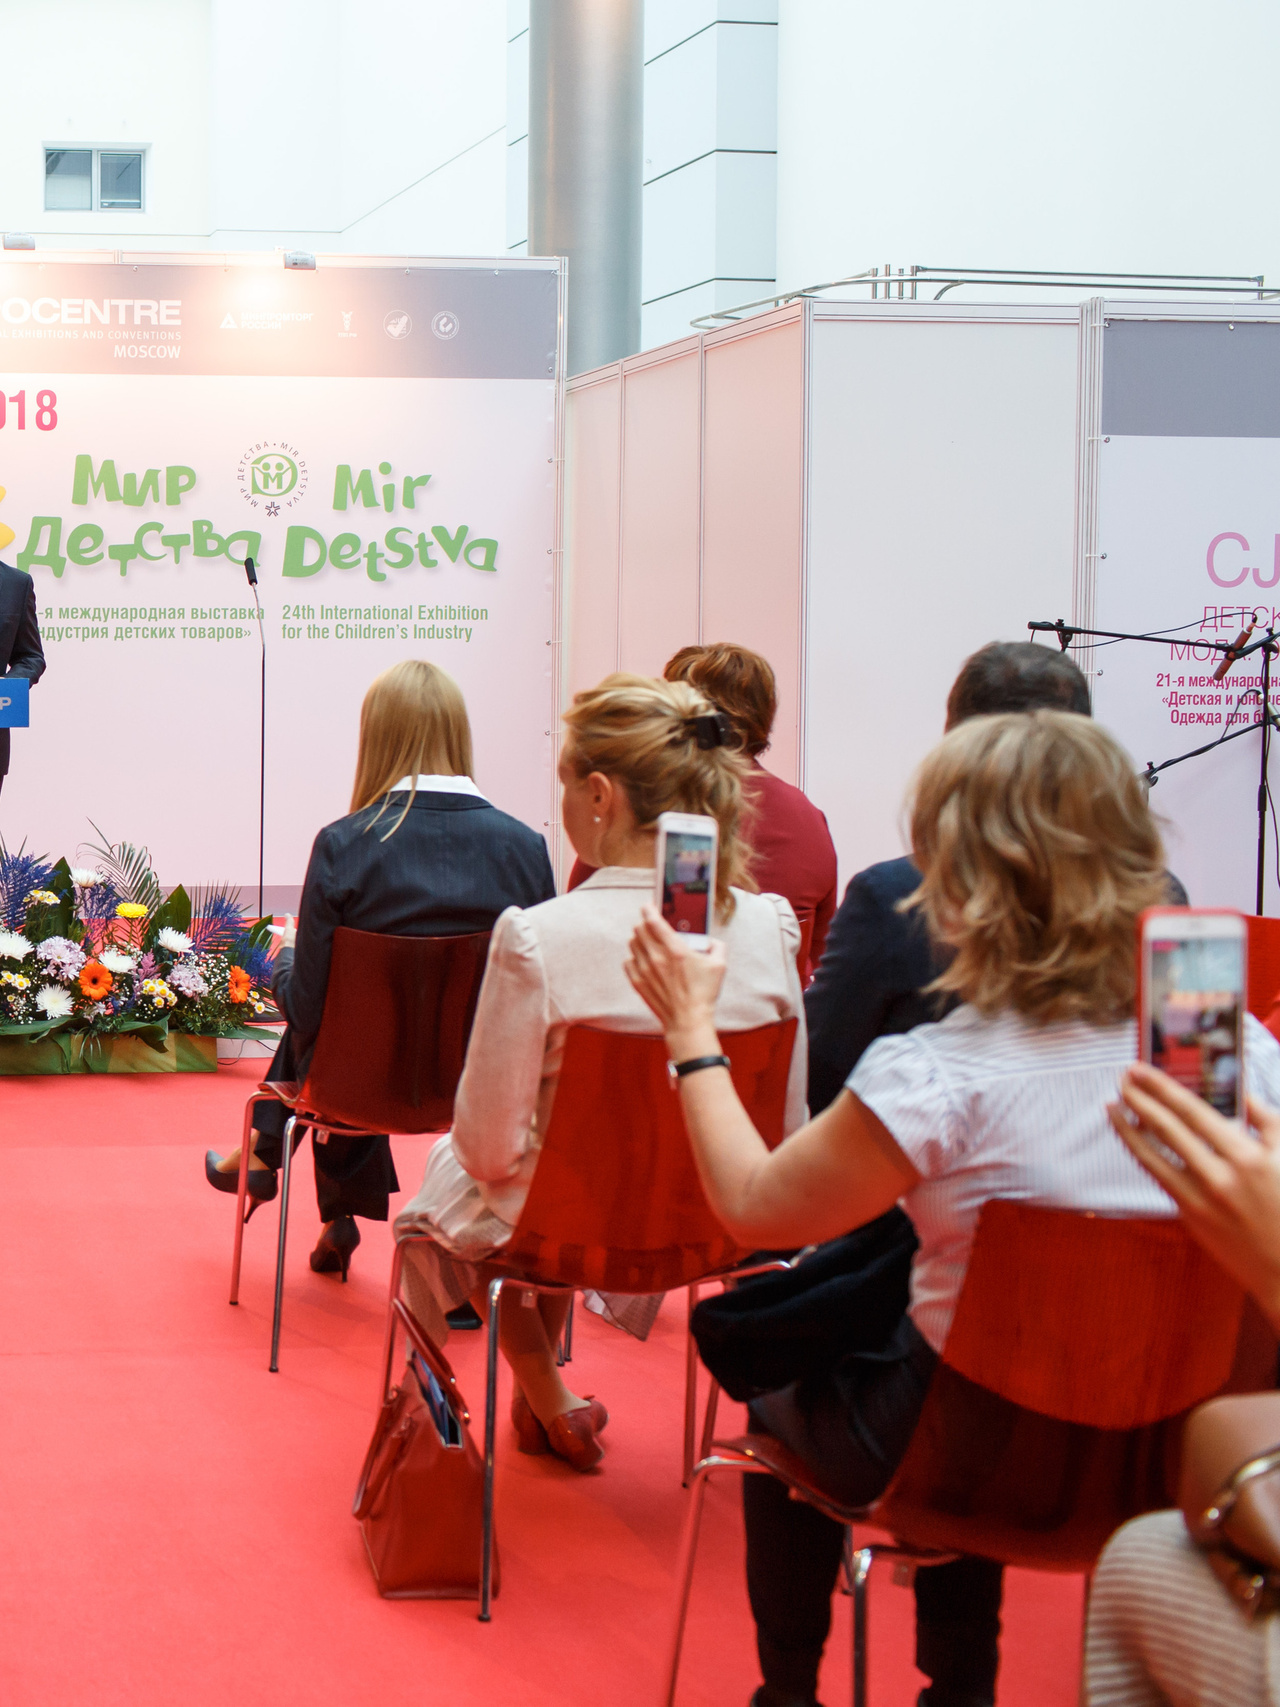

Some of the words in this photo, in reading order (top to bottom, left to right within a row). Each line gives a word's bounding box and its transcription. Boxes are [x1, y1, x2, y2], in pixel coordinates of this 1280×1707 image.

[12, 329, 79, 339] EXHIBITIONS
[83, 330, 104, 339] AND
[108, 330, 181, 340] CONVENTIONS
[113, 345, 181, 358] MOSCOW
[332, 461, 432, 513] Mir
[38, 608, 53, 619] -я
[58, 608, 186, 622] международная
[191, 608, 265, 620] выставка
[282, 605, 315, 620] 24th
[320, 605, 413, 620] International
[418, 605, 488, 620] Exhibition
[38, 627, 109, 642] ндустрия
[114, 626, 176, 641] детских
[181, 626, 251, 642] товаров»
[282, 624, 302, 639] for
[307, 624, 329, 639] the
[413, 624, 472, 642] Industry
[1156, 673, 1184, 687] 21-я
[1161, 691, 1221, 708] «Детская
[1225, 694, 1233, 705] и
[1170, 710, 1222, 726] Одежда
[1226, 712, 1249, 726] для
